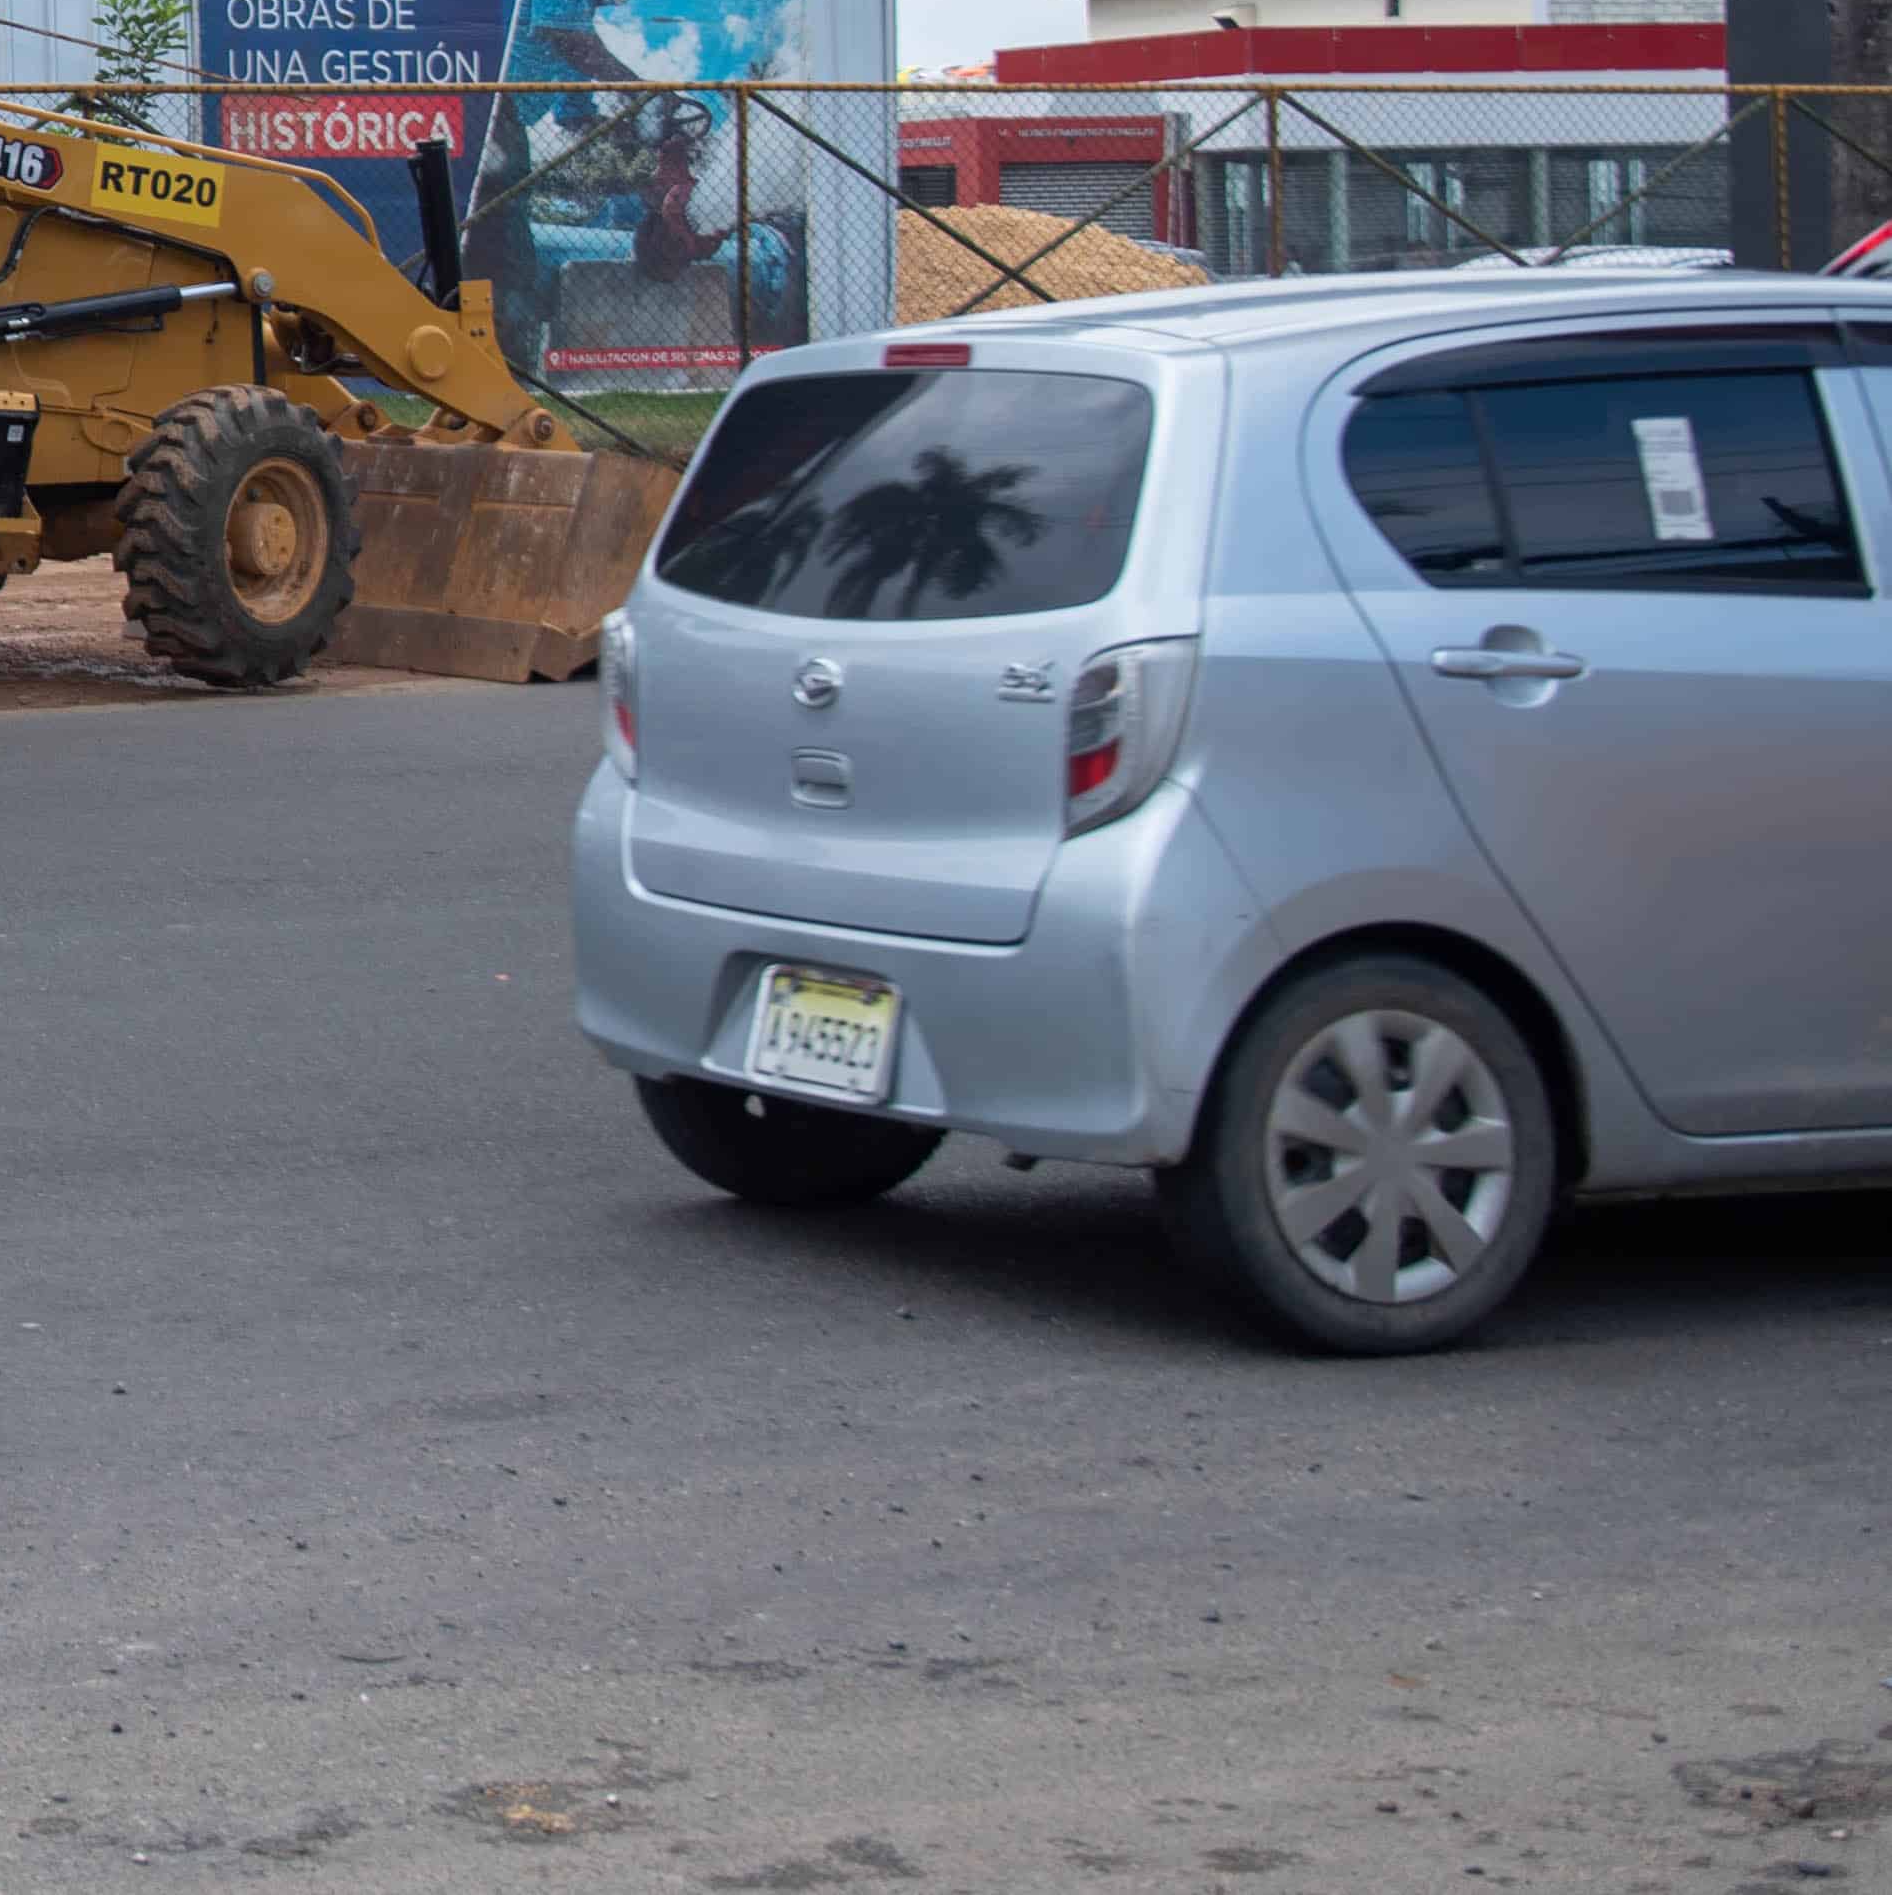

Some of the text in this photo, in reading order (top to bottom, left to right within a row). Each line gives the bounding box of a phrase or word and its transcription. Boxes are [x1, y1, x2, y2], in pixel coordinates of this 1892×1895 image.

[228, 41, 480, 84] UNA GESTIÓN
[229, 101, 455, 152] HISTÓRICA
[99, 161, 216, 208] RT020
